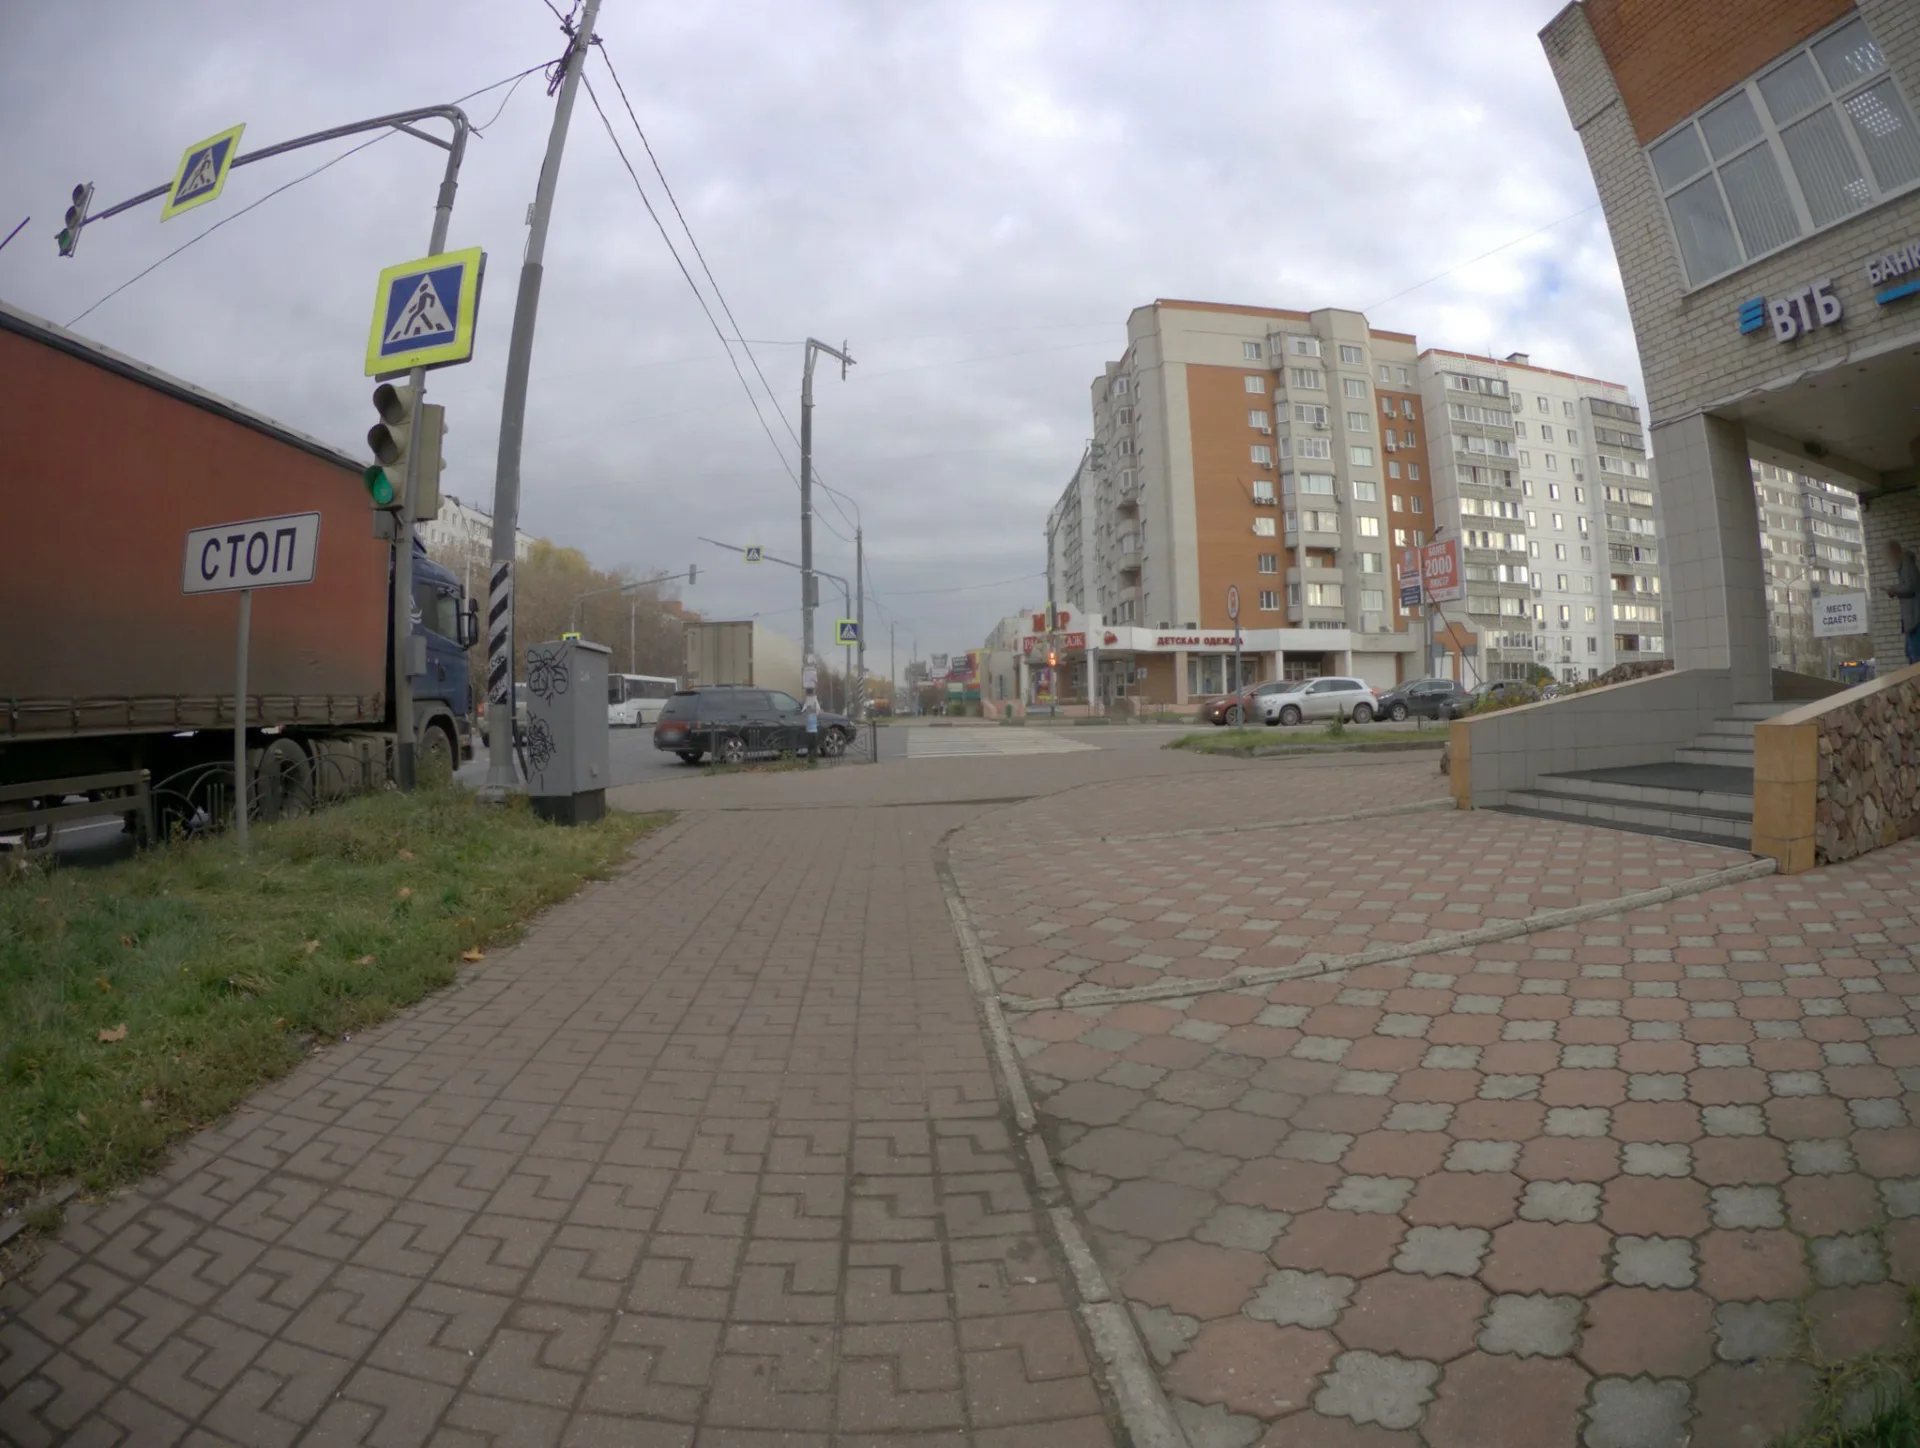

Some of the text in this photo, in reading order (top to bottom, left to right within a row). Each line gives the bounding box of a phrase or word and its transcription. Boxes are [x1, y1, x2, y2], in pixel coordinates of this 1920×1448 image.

[1768, 278, 1843, 343] ВТБ
[201, 527, 297, 581] СТОП
[1425, 555, 1453, 577] 2000
[1826, 603, 1852, 613] МЕСТО
[1032, 610, 1070, 632] МР
[1157, 636, 1200, 646] ДЕТСКАЯ
